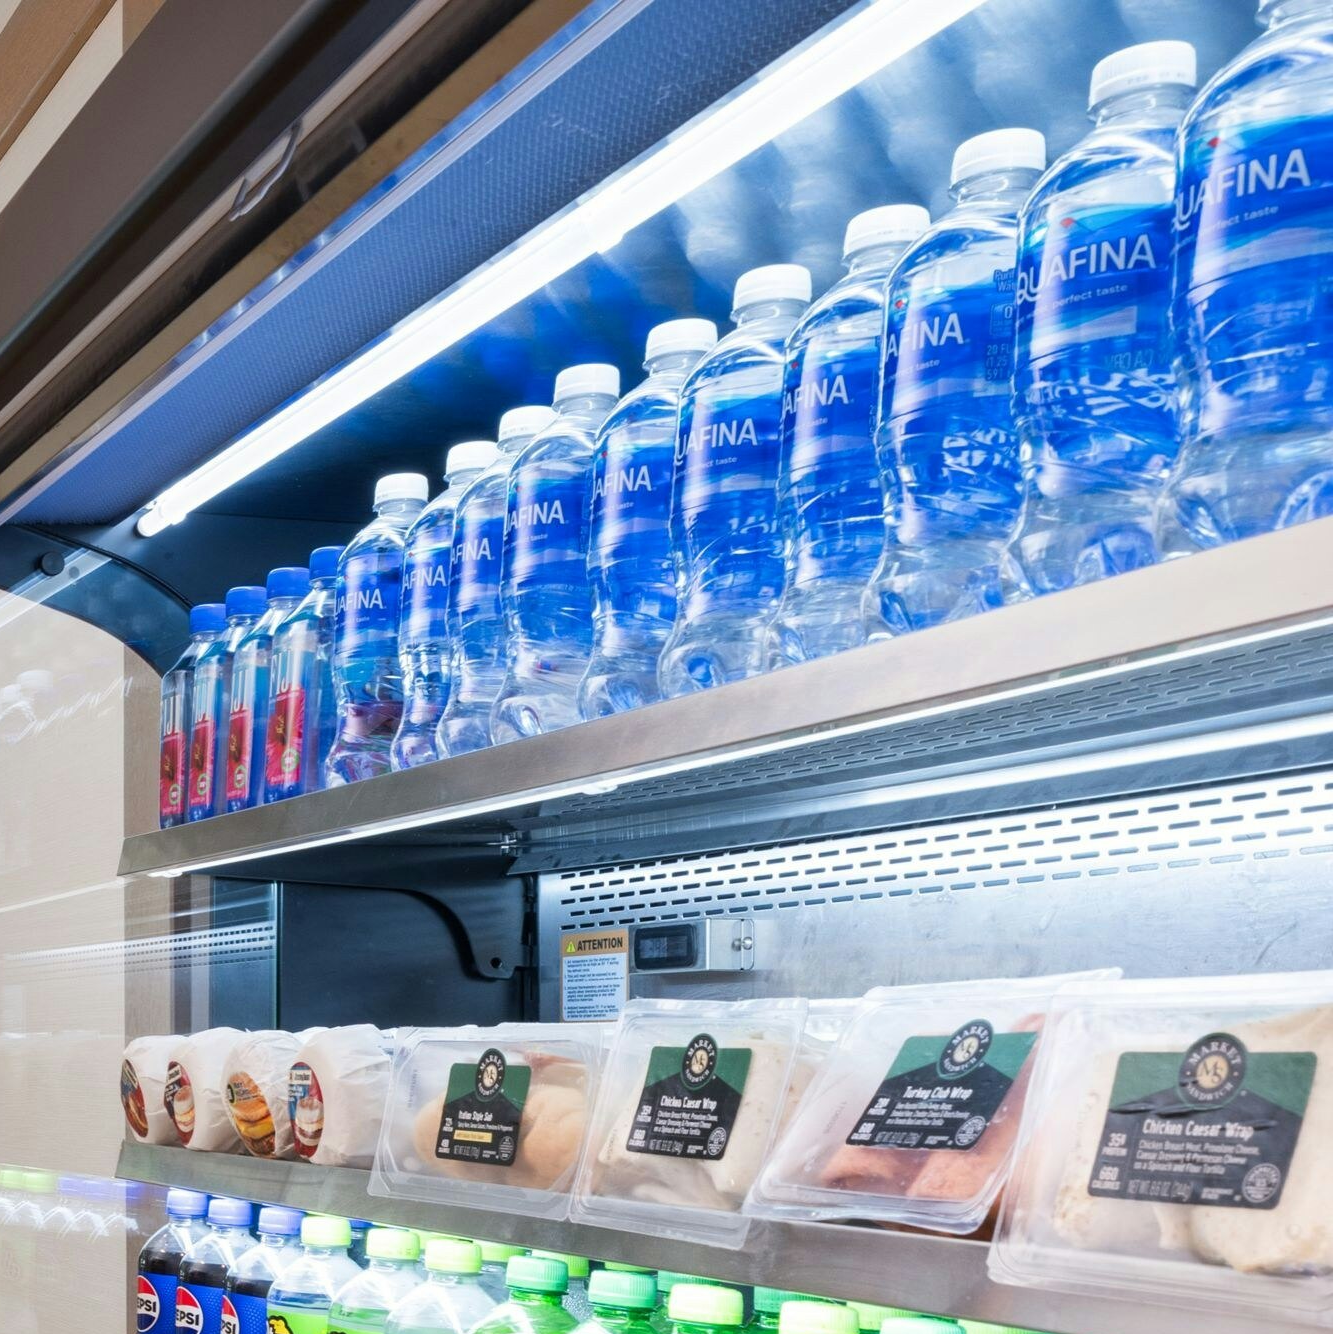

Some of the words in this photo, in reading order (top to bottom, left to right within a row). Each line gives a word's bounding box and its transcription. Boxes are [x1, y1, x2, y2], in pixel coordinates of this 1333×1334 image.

[1243, 204, 1280, 222] taste
[1016, 233, 1158, 305] QUAFINA
[1095, 283, 1129, 298] taste
[715, 456, 738, 467] taste
[577, 936, 624, 952] ATTENTION
[951, 1025, 990, 1047] MARKET
[687, 1039, 715, 1058] MARKET
[1188, 1041, 1242, 1066] MARKET
[479, 1054, 504, 1072] MARKET
[902, 1086, 930, 1101] Turkey
[930, 1085, 950, 1100] Club
[950, 1086, 973, 1101] Wrap
[659, 1095, 682, 1109] Chicken
[682, 1096, 702, 1110] Caesar
[702, 1097, 718, 1111] Wrap
[457, 1109, 472, 1121] Italian
[472, 1110, 484, 1122] Style
[1142, 1119, 1183, 1138] Chicken
[1185, 1120, 1222, 1138] Caesar
[1223, 1121, 1255, 1142] Wrap
[1138, 1140, 1164, 1151] Chicken
[175, 1308, 200, 1326] EPSI
